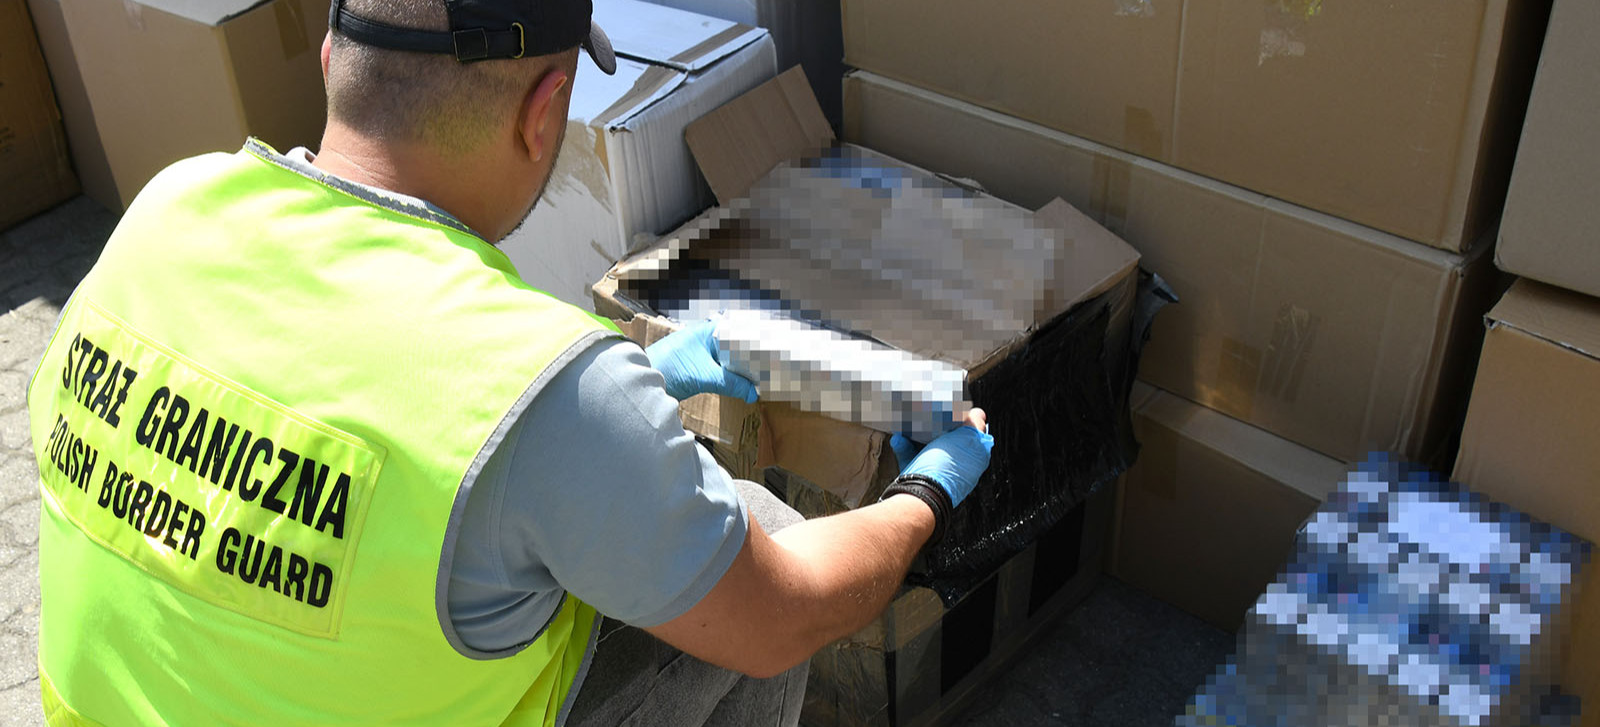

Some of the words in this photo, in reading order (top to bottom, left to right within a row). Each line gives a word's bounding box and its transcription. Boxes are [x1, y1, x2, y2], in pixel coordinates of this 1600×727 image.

[44, 413, 98, 494] POLISH
[97, 460, 206, 560] BORDER
[215, 527, 333, 608] GUARD
[135, 386, 351, 539] GRANICZNA
